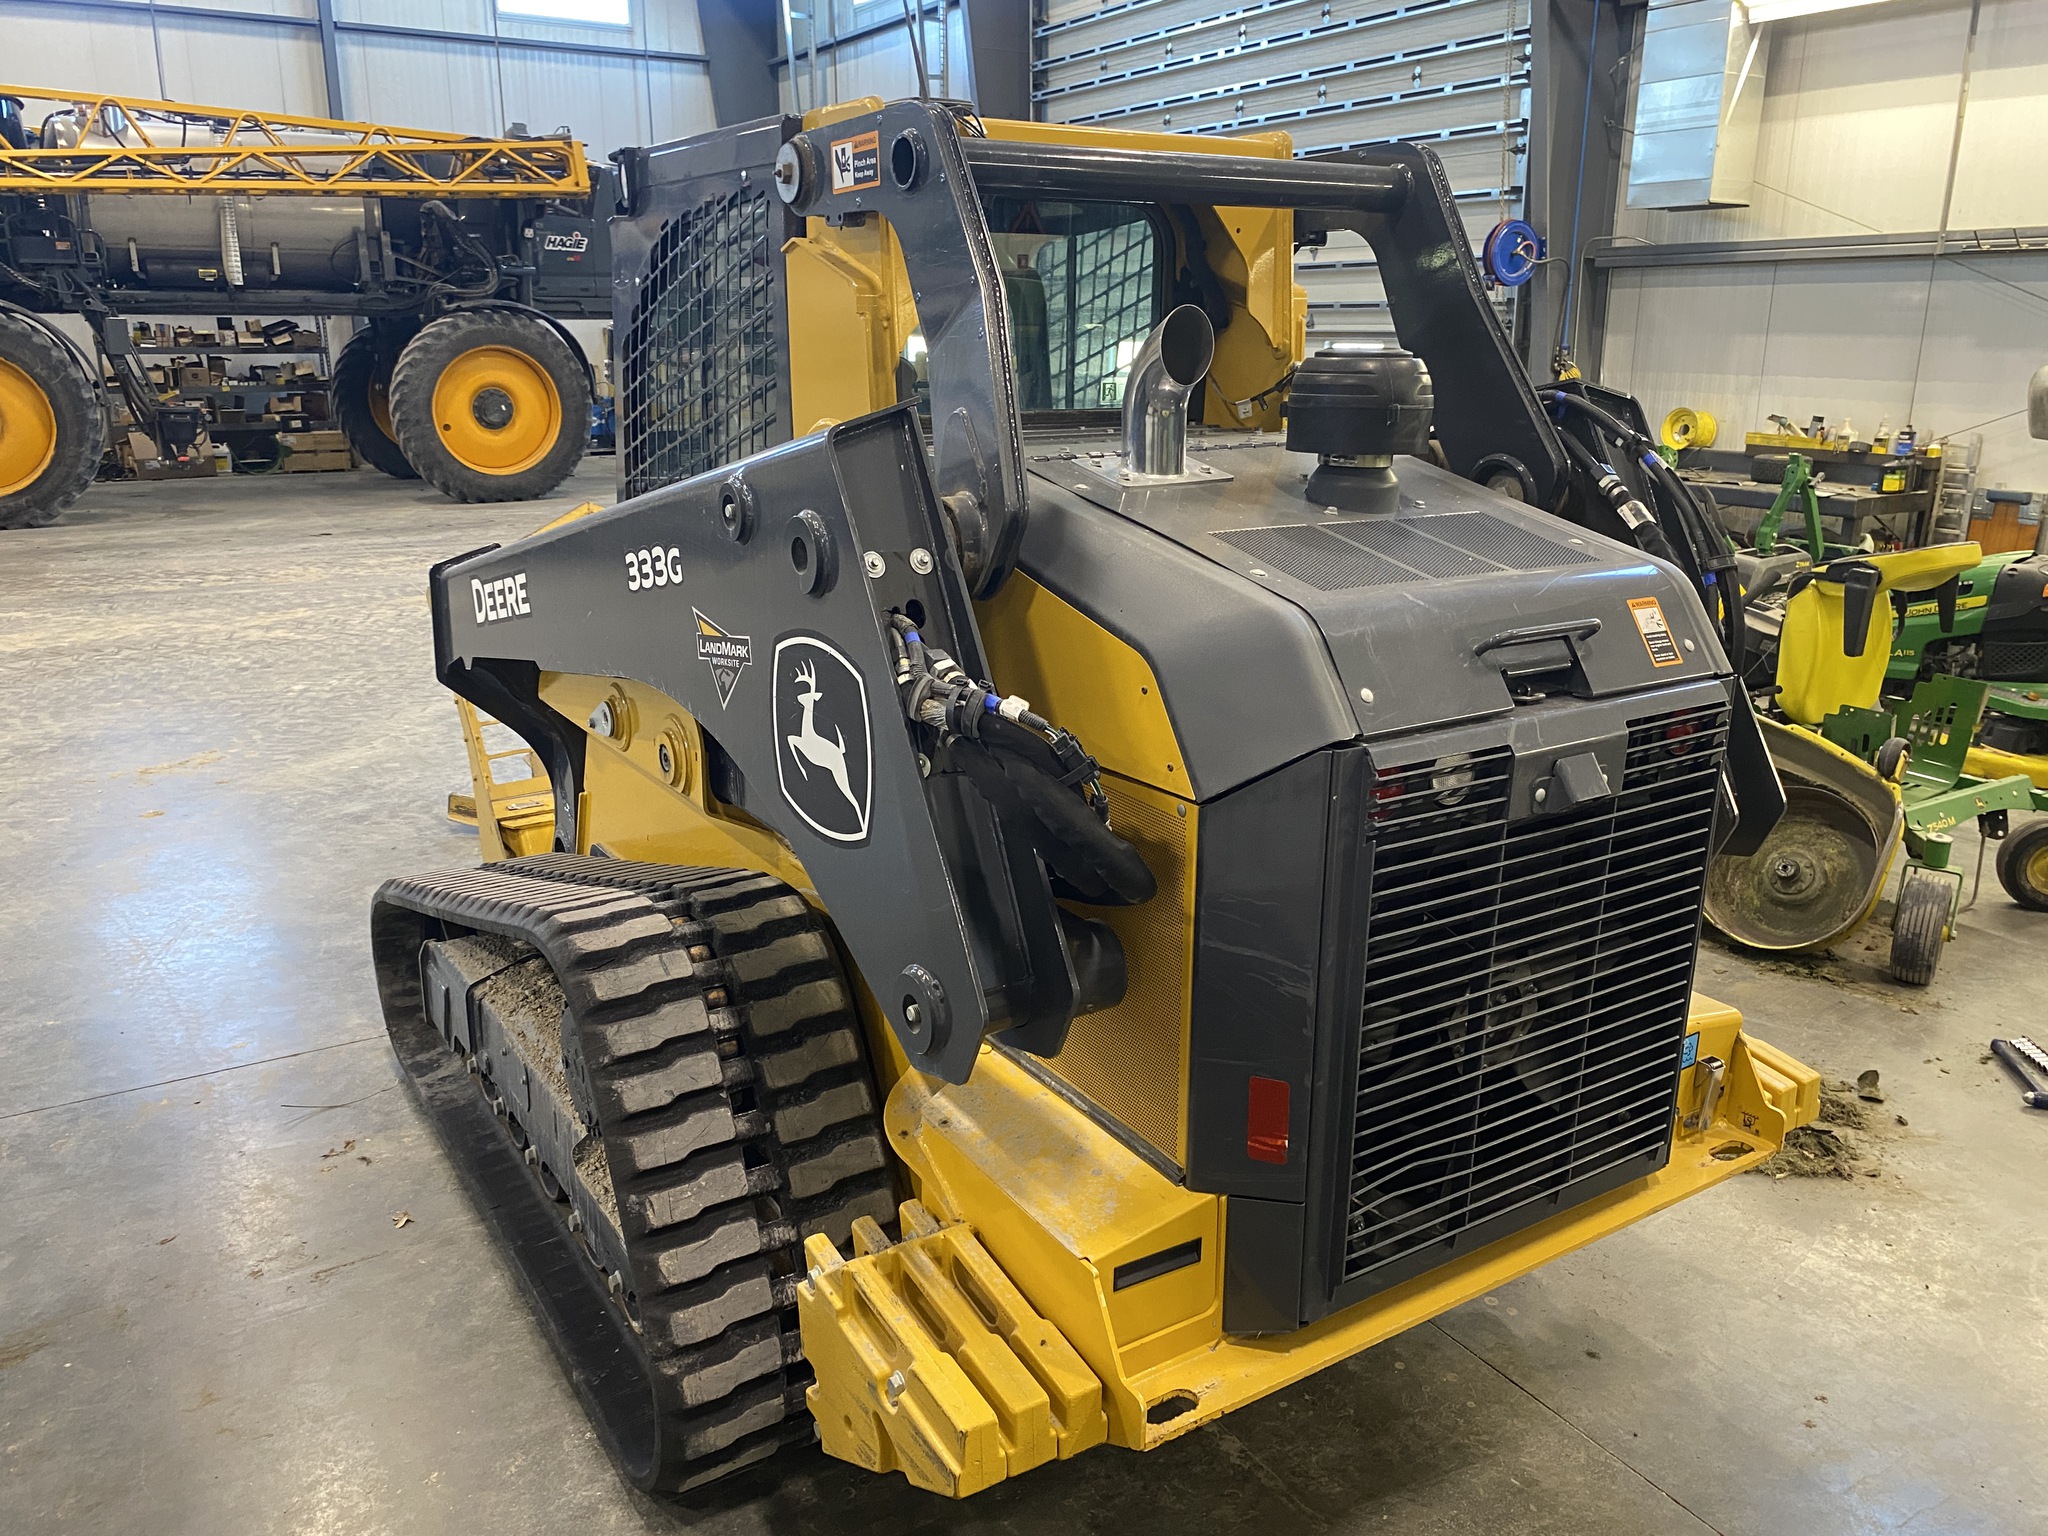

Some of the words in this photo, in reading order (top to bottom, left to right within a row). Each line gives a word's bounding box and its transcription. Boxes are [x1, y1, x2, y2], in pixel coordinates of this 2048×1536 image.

[854, 158, 866, 168] Pinch
[867, 157, 876, 165] Area
[545, 232, 587, 251] HAGIE
[625, 546, 683, 591] 333G
[471, 573, 530, 624] DEERE
[1906, 607, 1932, 616] JOHN
[1935, 602, 1968, 614] DRE
[712, 657, 740, 668] WORKSITE
